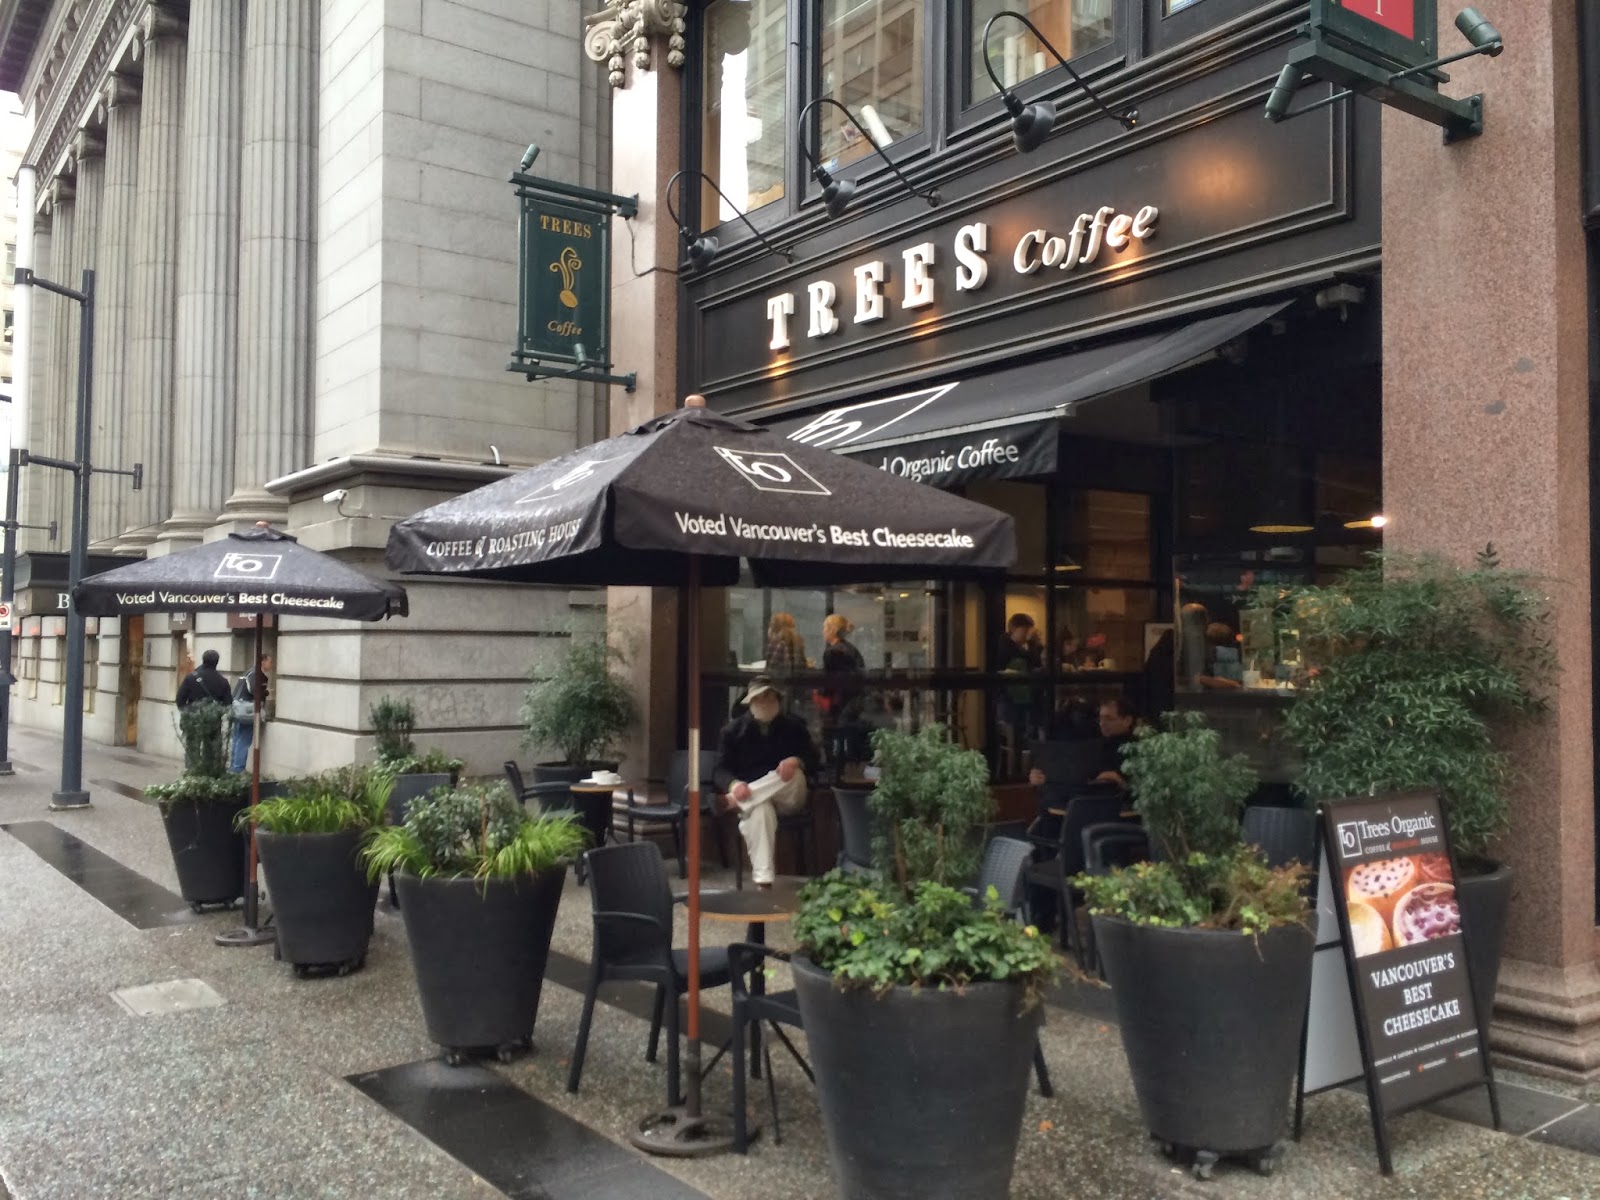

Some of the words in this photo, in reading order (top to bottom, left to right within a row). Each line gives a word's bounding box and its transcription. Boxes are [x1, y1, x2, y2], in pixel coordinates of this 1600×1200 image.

[540, 215, 592, 239] TREES
[766, 222, 988, 350] TREES
[1012, 205, 1158, 275] Coffee
[547, 320, 583, 337] Coffee
[890, 450, 954, 482] Organic
[957, 438, 1019, 469] Coffee
[426, 540, 472, 557] COFFEE
[489, 529, 546, 554] ROASTING
[675, 512, 726, 536] Voted
[729, 516, 825, 545] Vancouver's
[829, 525, 870, 547] Best
[872, 528, 975, 549] Cheesecake
[116, 591, 155, 605] Voted
[159, 590, 235, 605] Vancouver's
[238, 592, 268, 604] Best
[271, 592, 344, 609] Cheesecake
[1358, 820, 1390, 839] Trees
[1391, 810, 1436, 838] Organic
[1371, 952, 1455, 989] VANCOUVER'S
[1403, 982, 1433, 1005] BEST
[1383, 999, 1461, 1037] CHEESECAKE
